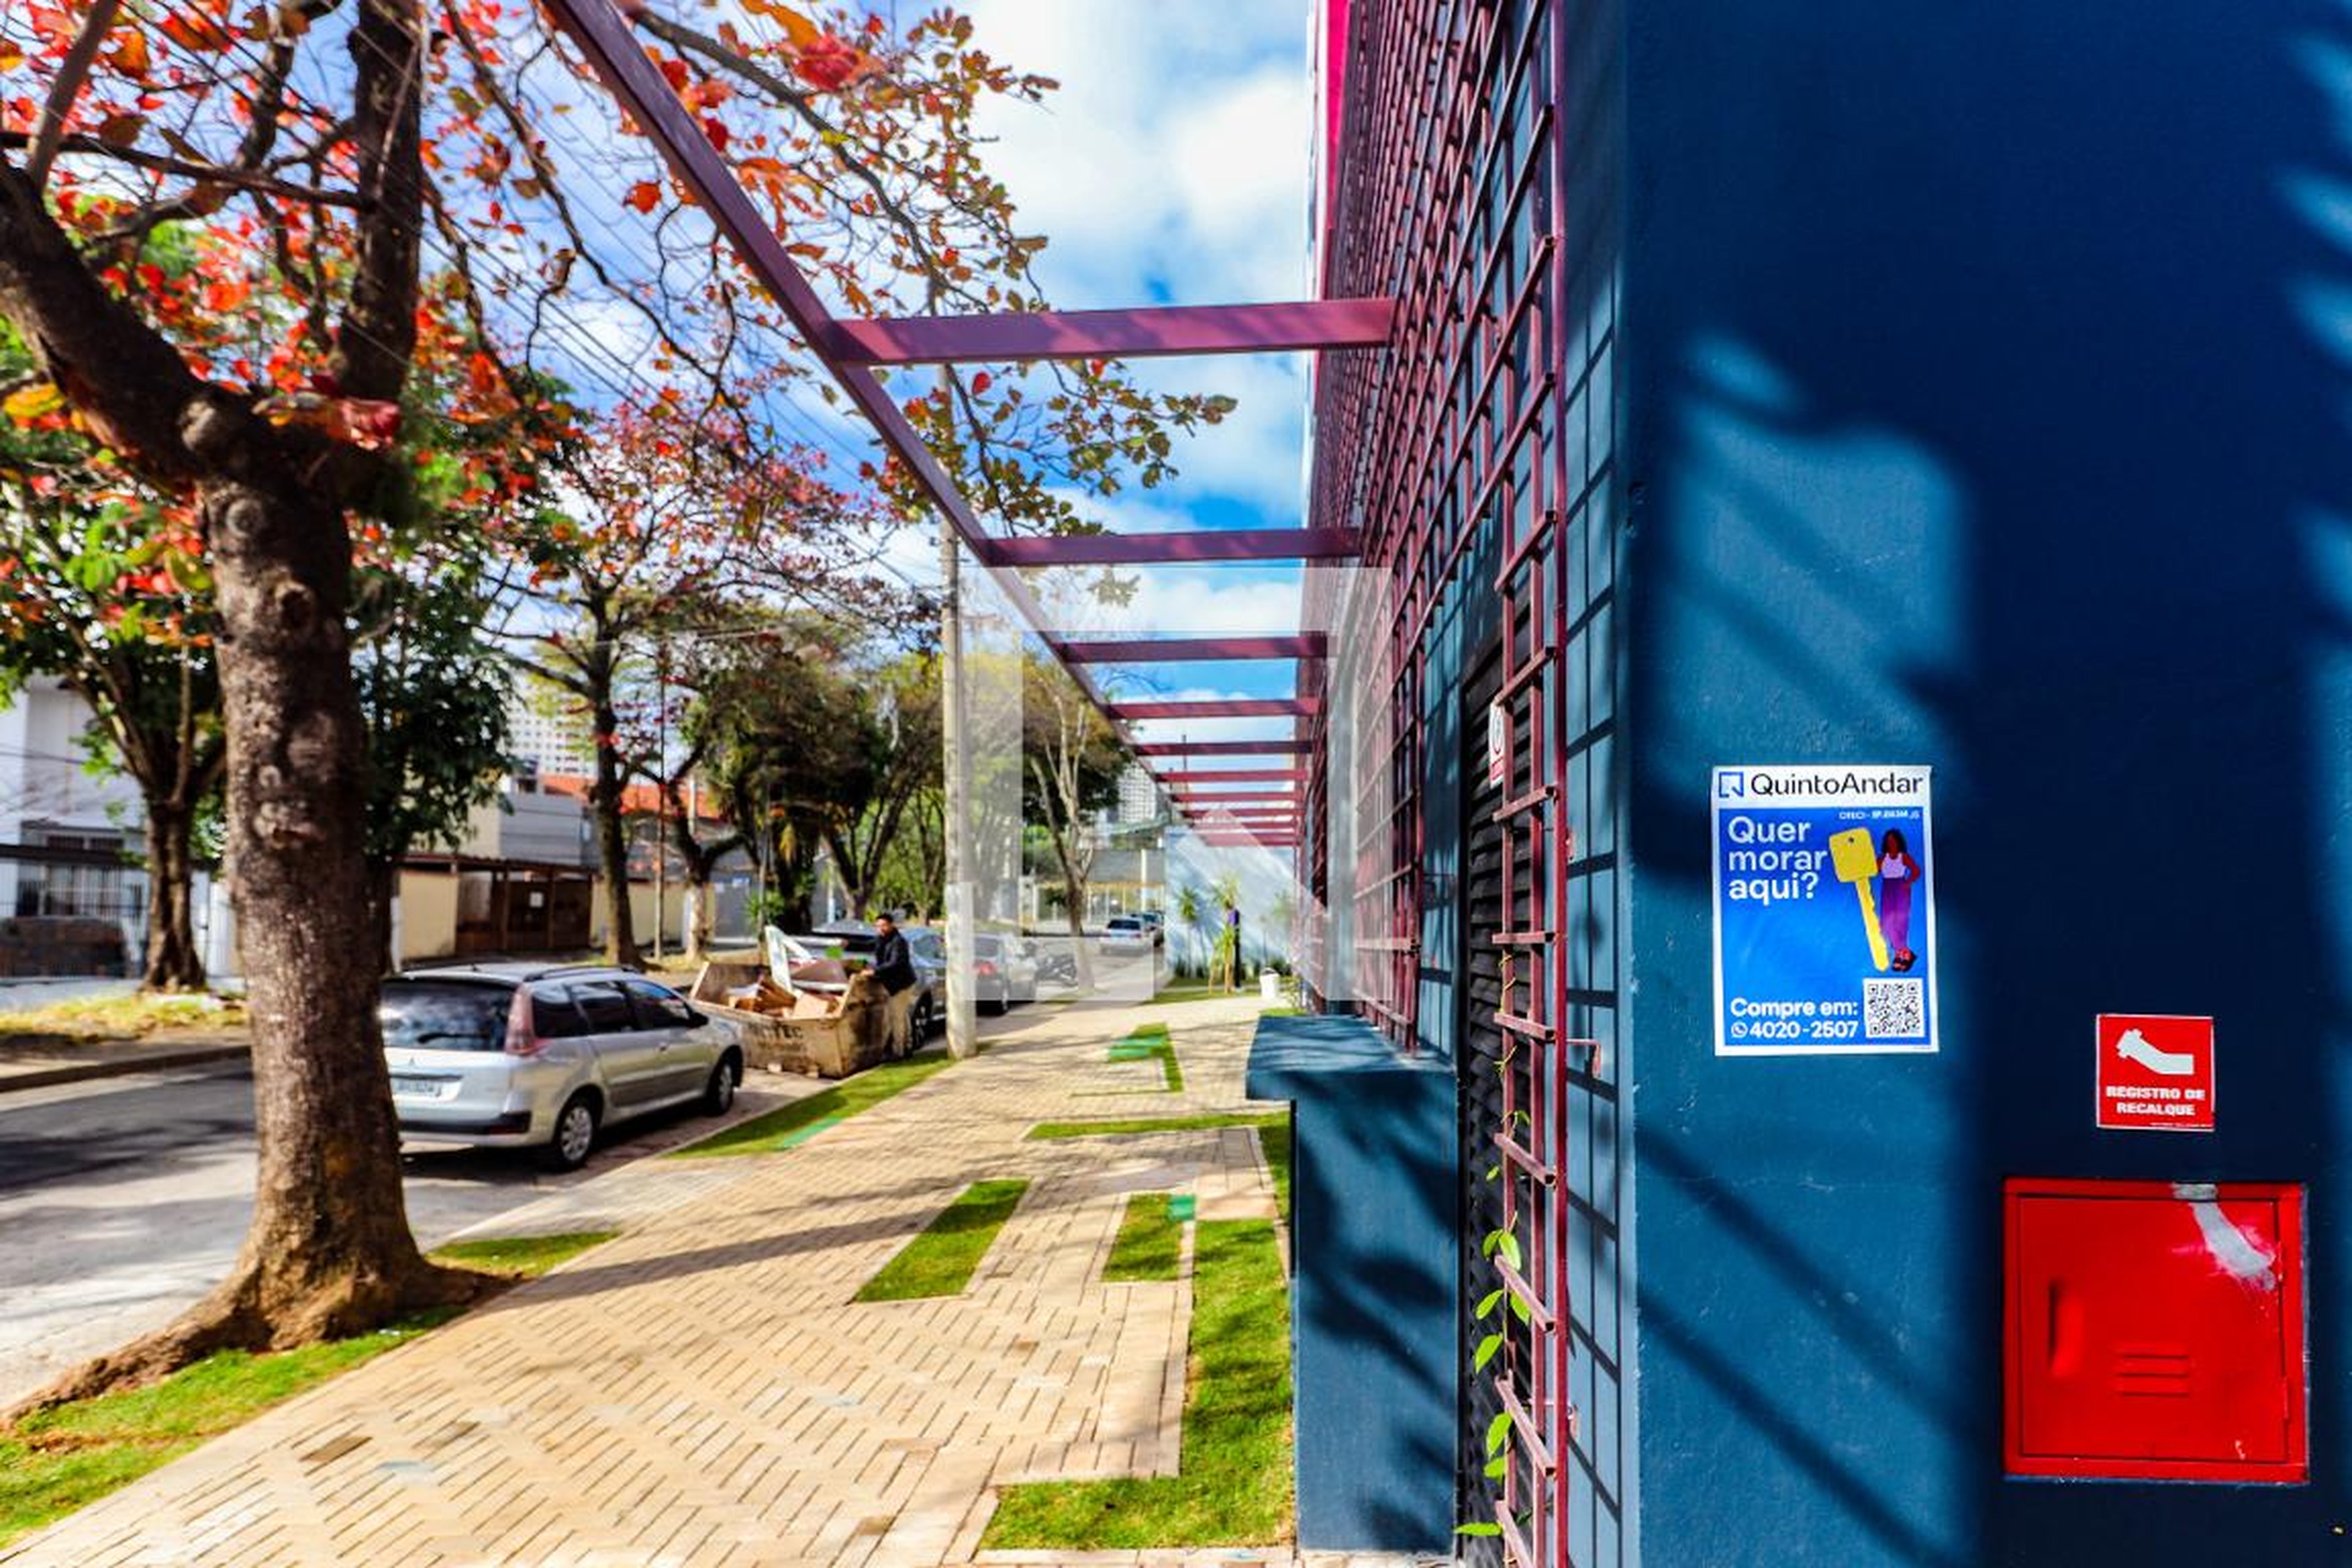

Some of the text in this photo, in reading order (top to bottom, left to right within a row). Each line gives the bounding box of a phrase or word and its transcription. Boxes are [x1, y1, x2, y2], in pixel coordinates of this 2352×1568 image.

[1751, 772, 1923, 796] QuintoAndar
[1728, 816, 1811, 843] Quer
[1728, 850, 1827, 871] morar
[1728, 872, 1818, 905] aqui?
[1730, 998, 1858, 1019] Compre em:
[1749, 1022, 1858, 1038] 4020-2507
[2106, 1086, 2205, 1100] REGISTRO DE
[2116, 1102, 2196, 1117] RECALQUE
